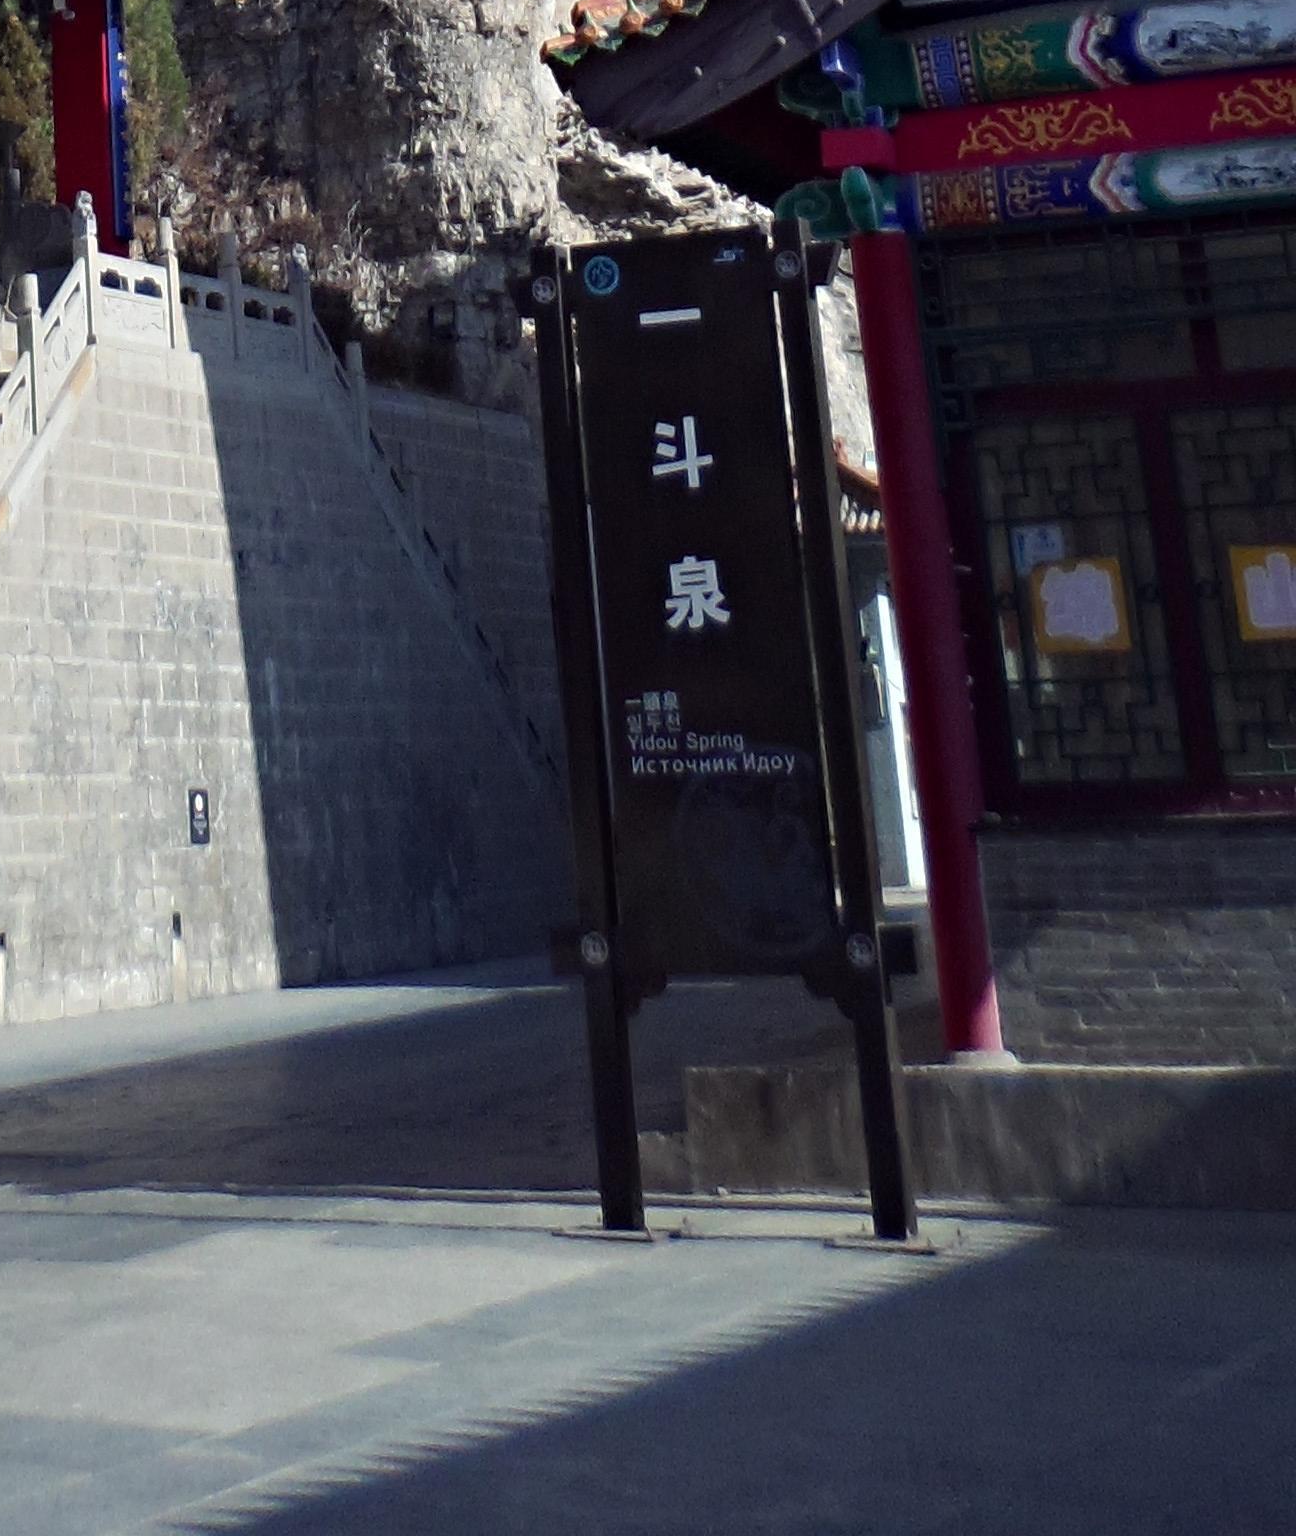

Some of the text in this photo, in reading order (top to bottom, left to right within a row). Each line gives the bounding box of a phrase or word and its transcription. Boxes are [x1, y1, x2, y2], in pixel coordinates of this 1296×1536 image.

[639, 308, 731, 629] 一斗泉
[627, 732, 744, 752] Yidou Spring
[632, 751, 795, 774] Источник Идоу
